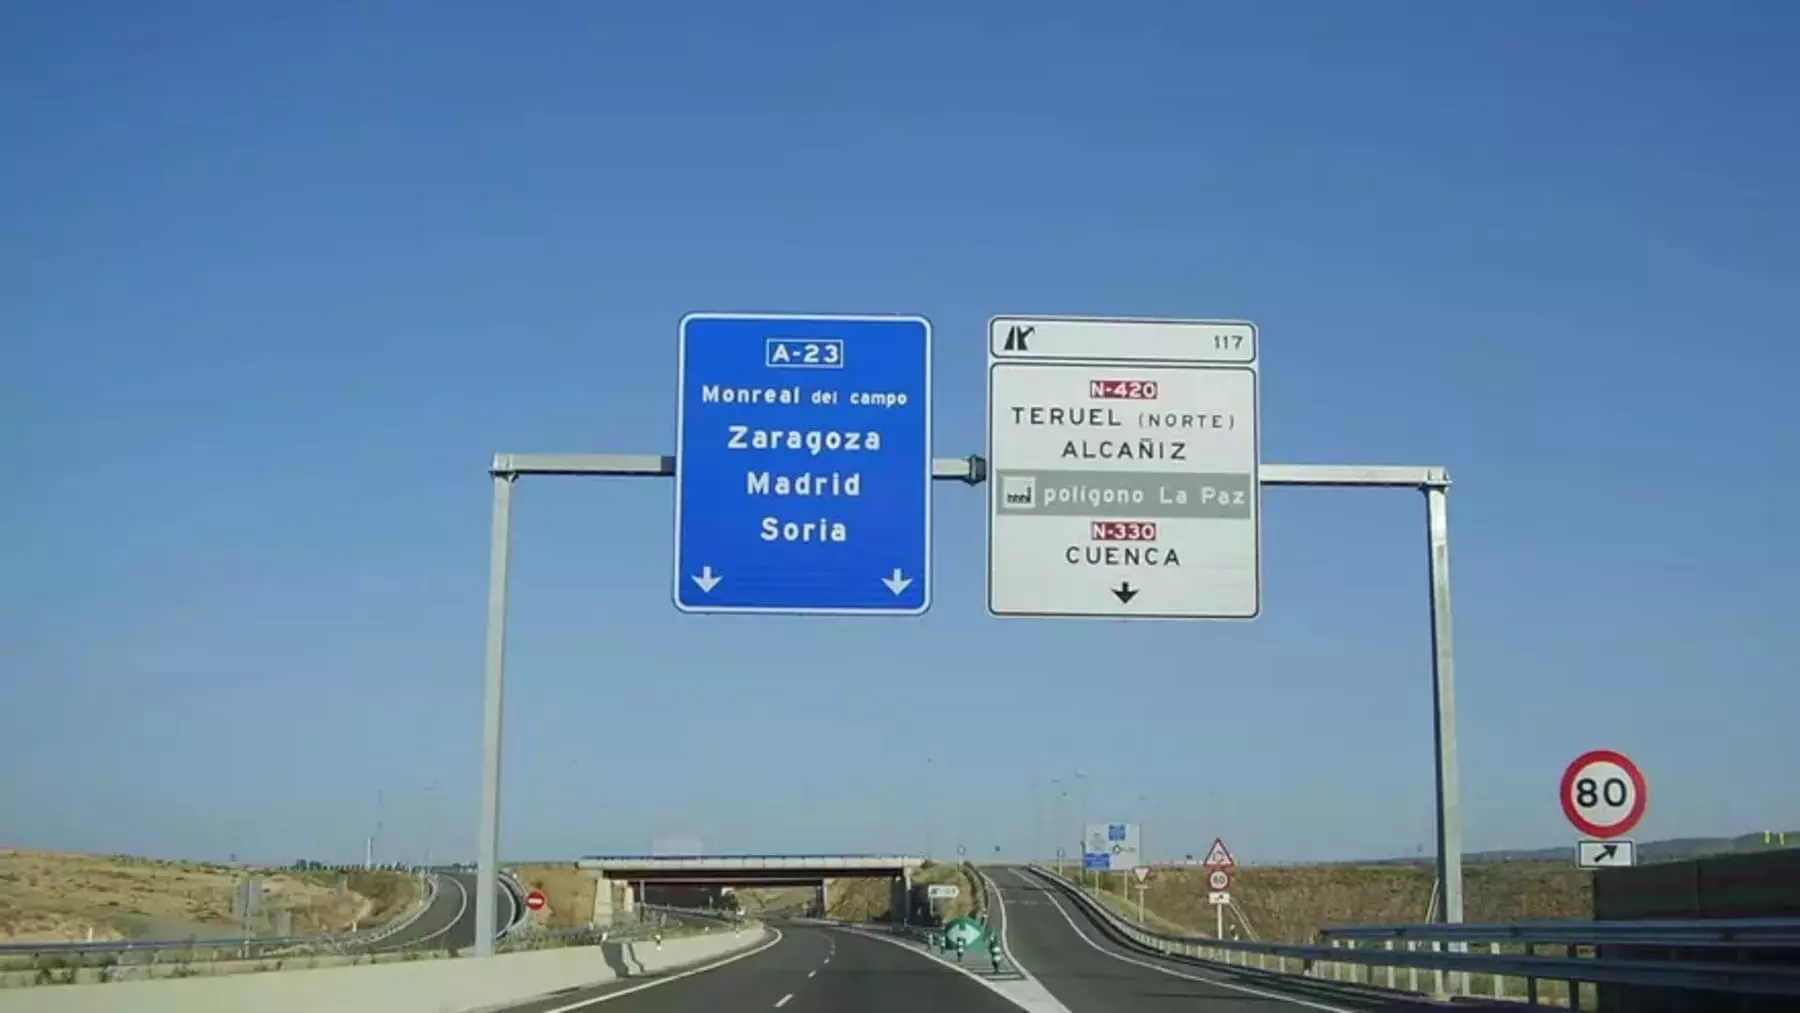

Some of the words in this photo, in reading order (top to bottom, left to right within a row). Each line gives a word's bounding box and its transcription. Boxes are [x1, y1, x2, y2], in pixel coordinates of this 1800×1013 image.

[772, 343, 839, 363] A-23
[1213, 334, 1244, 350] 117
[702, 385, 800, 404] Monreal
[811, 389, 838, 405] del
[849, 392, 908, 409] campo
[1091, 381, 1156, 398] N-420
[1011, 406, 1122, 427] TERUEL
[1138, 413, 1236, 430] (NORTE)
[727, 425, 881, 455] Zaragoza
[1061, 437, 1187, 461] ALCAÑIZ
[747, 471, 860, 496] Madrid
[1159, 486, 1188, 505] La
[1201, 487, 1245, 506] Paz
[760, 517, 847, 542] Soria
[1092, 523, 1156, 540] N-330
[1065, 545, 1180, 566] CUENCA
[1576, 777, 1628, 808] 80
